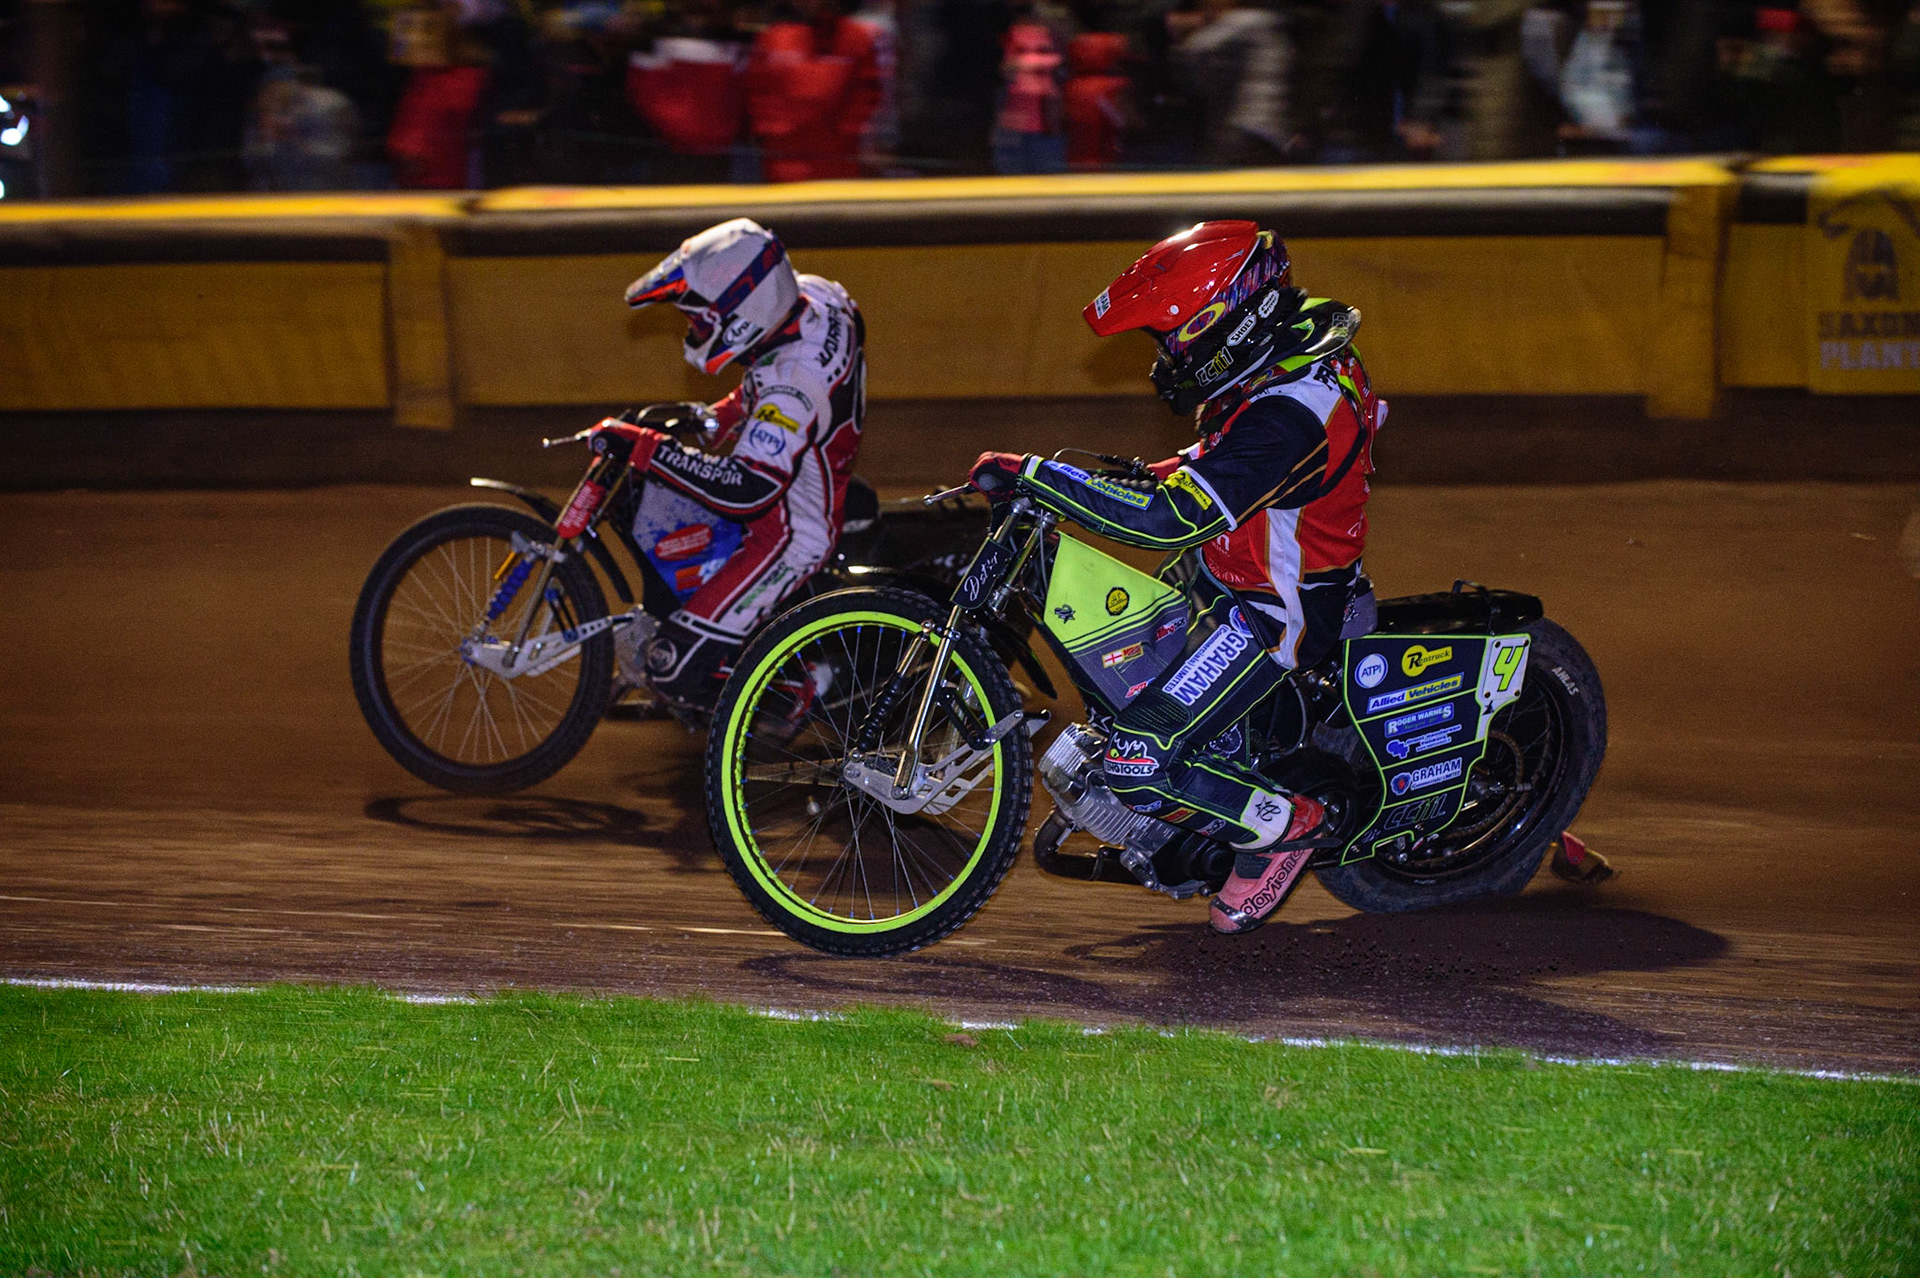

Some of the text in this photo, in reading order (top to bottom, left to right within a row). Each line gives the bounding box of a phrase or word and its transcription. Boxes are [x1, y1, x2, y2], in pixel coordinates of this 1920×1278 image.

[1231, 319, 1253, 342] SHOEI
[1175, 633, 1246, 704] GRAHAM
[1361, 664, 1382, 678] ATPI
[1407, 649, 1451, 670] Rentruck
[1493, 646, 1525, 692] 4
[1165, 663, 1190, 692] LIMITED
[1552, 667, 1580, 696] ANLAS
[1371, 678, 1458, 709] Allied Vehicles
[1387, 714, 1417, 734] ROGER
[1418, 706, 1452, 721] WARNES
[1413, 759, 1461, 782] GRAHAM
[1240, 849, 1305, 916] daytona
